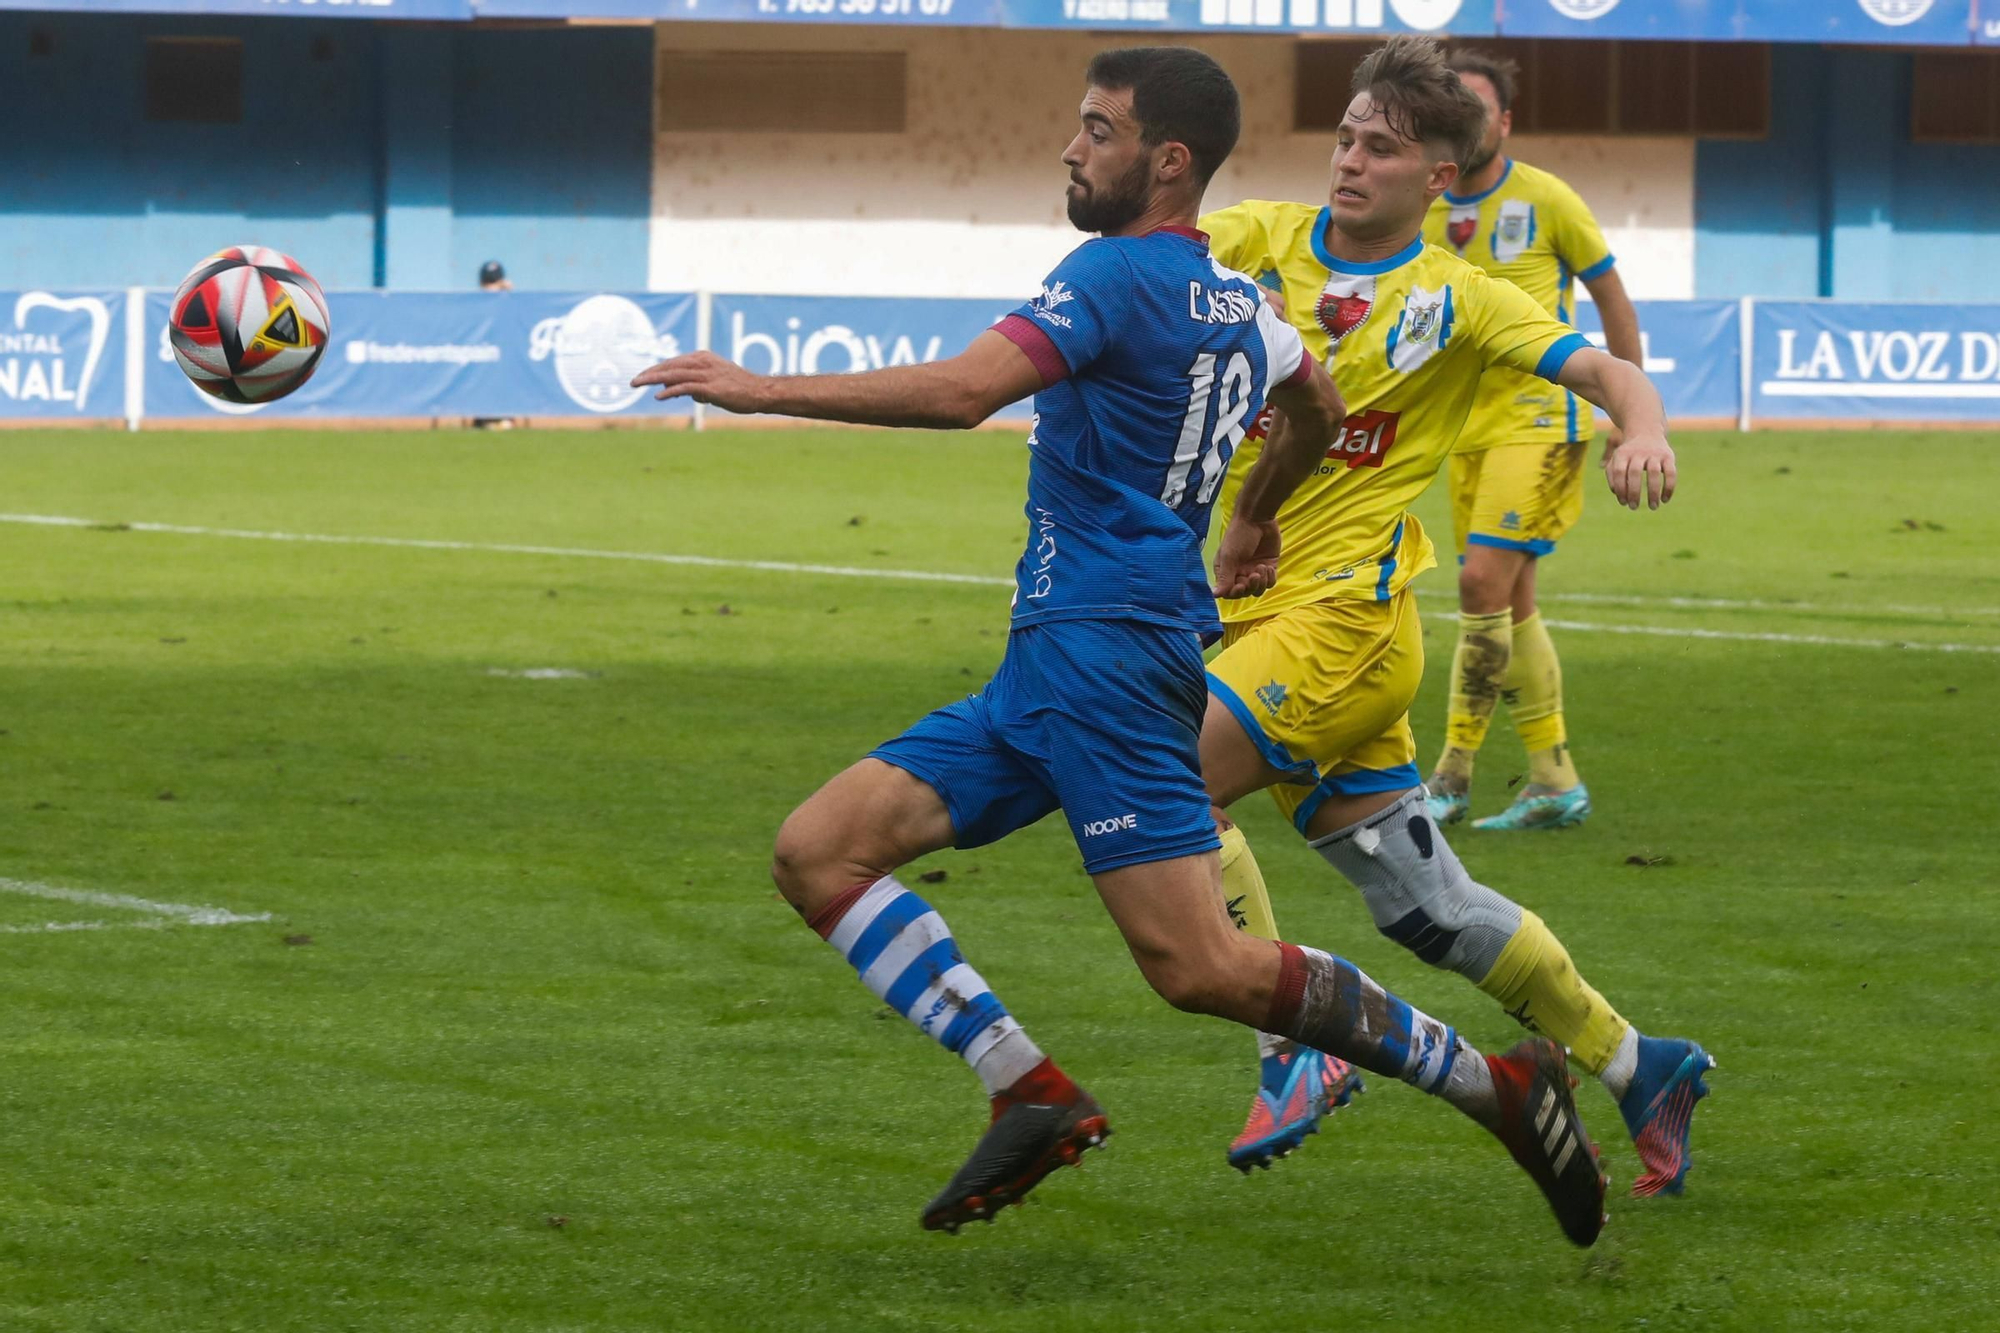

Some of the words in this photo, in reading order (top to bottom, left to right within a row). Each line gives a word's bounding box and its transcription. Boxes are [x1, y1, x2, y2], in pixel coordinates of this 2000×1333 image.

[1776, 329, 1845, 379] LA
[1848, 330, 1951, 381] VOZ
[1959, 331, 2000, 380] D
[1160, 352, 1252, 509] 18
